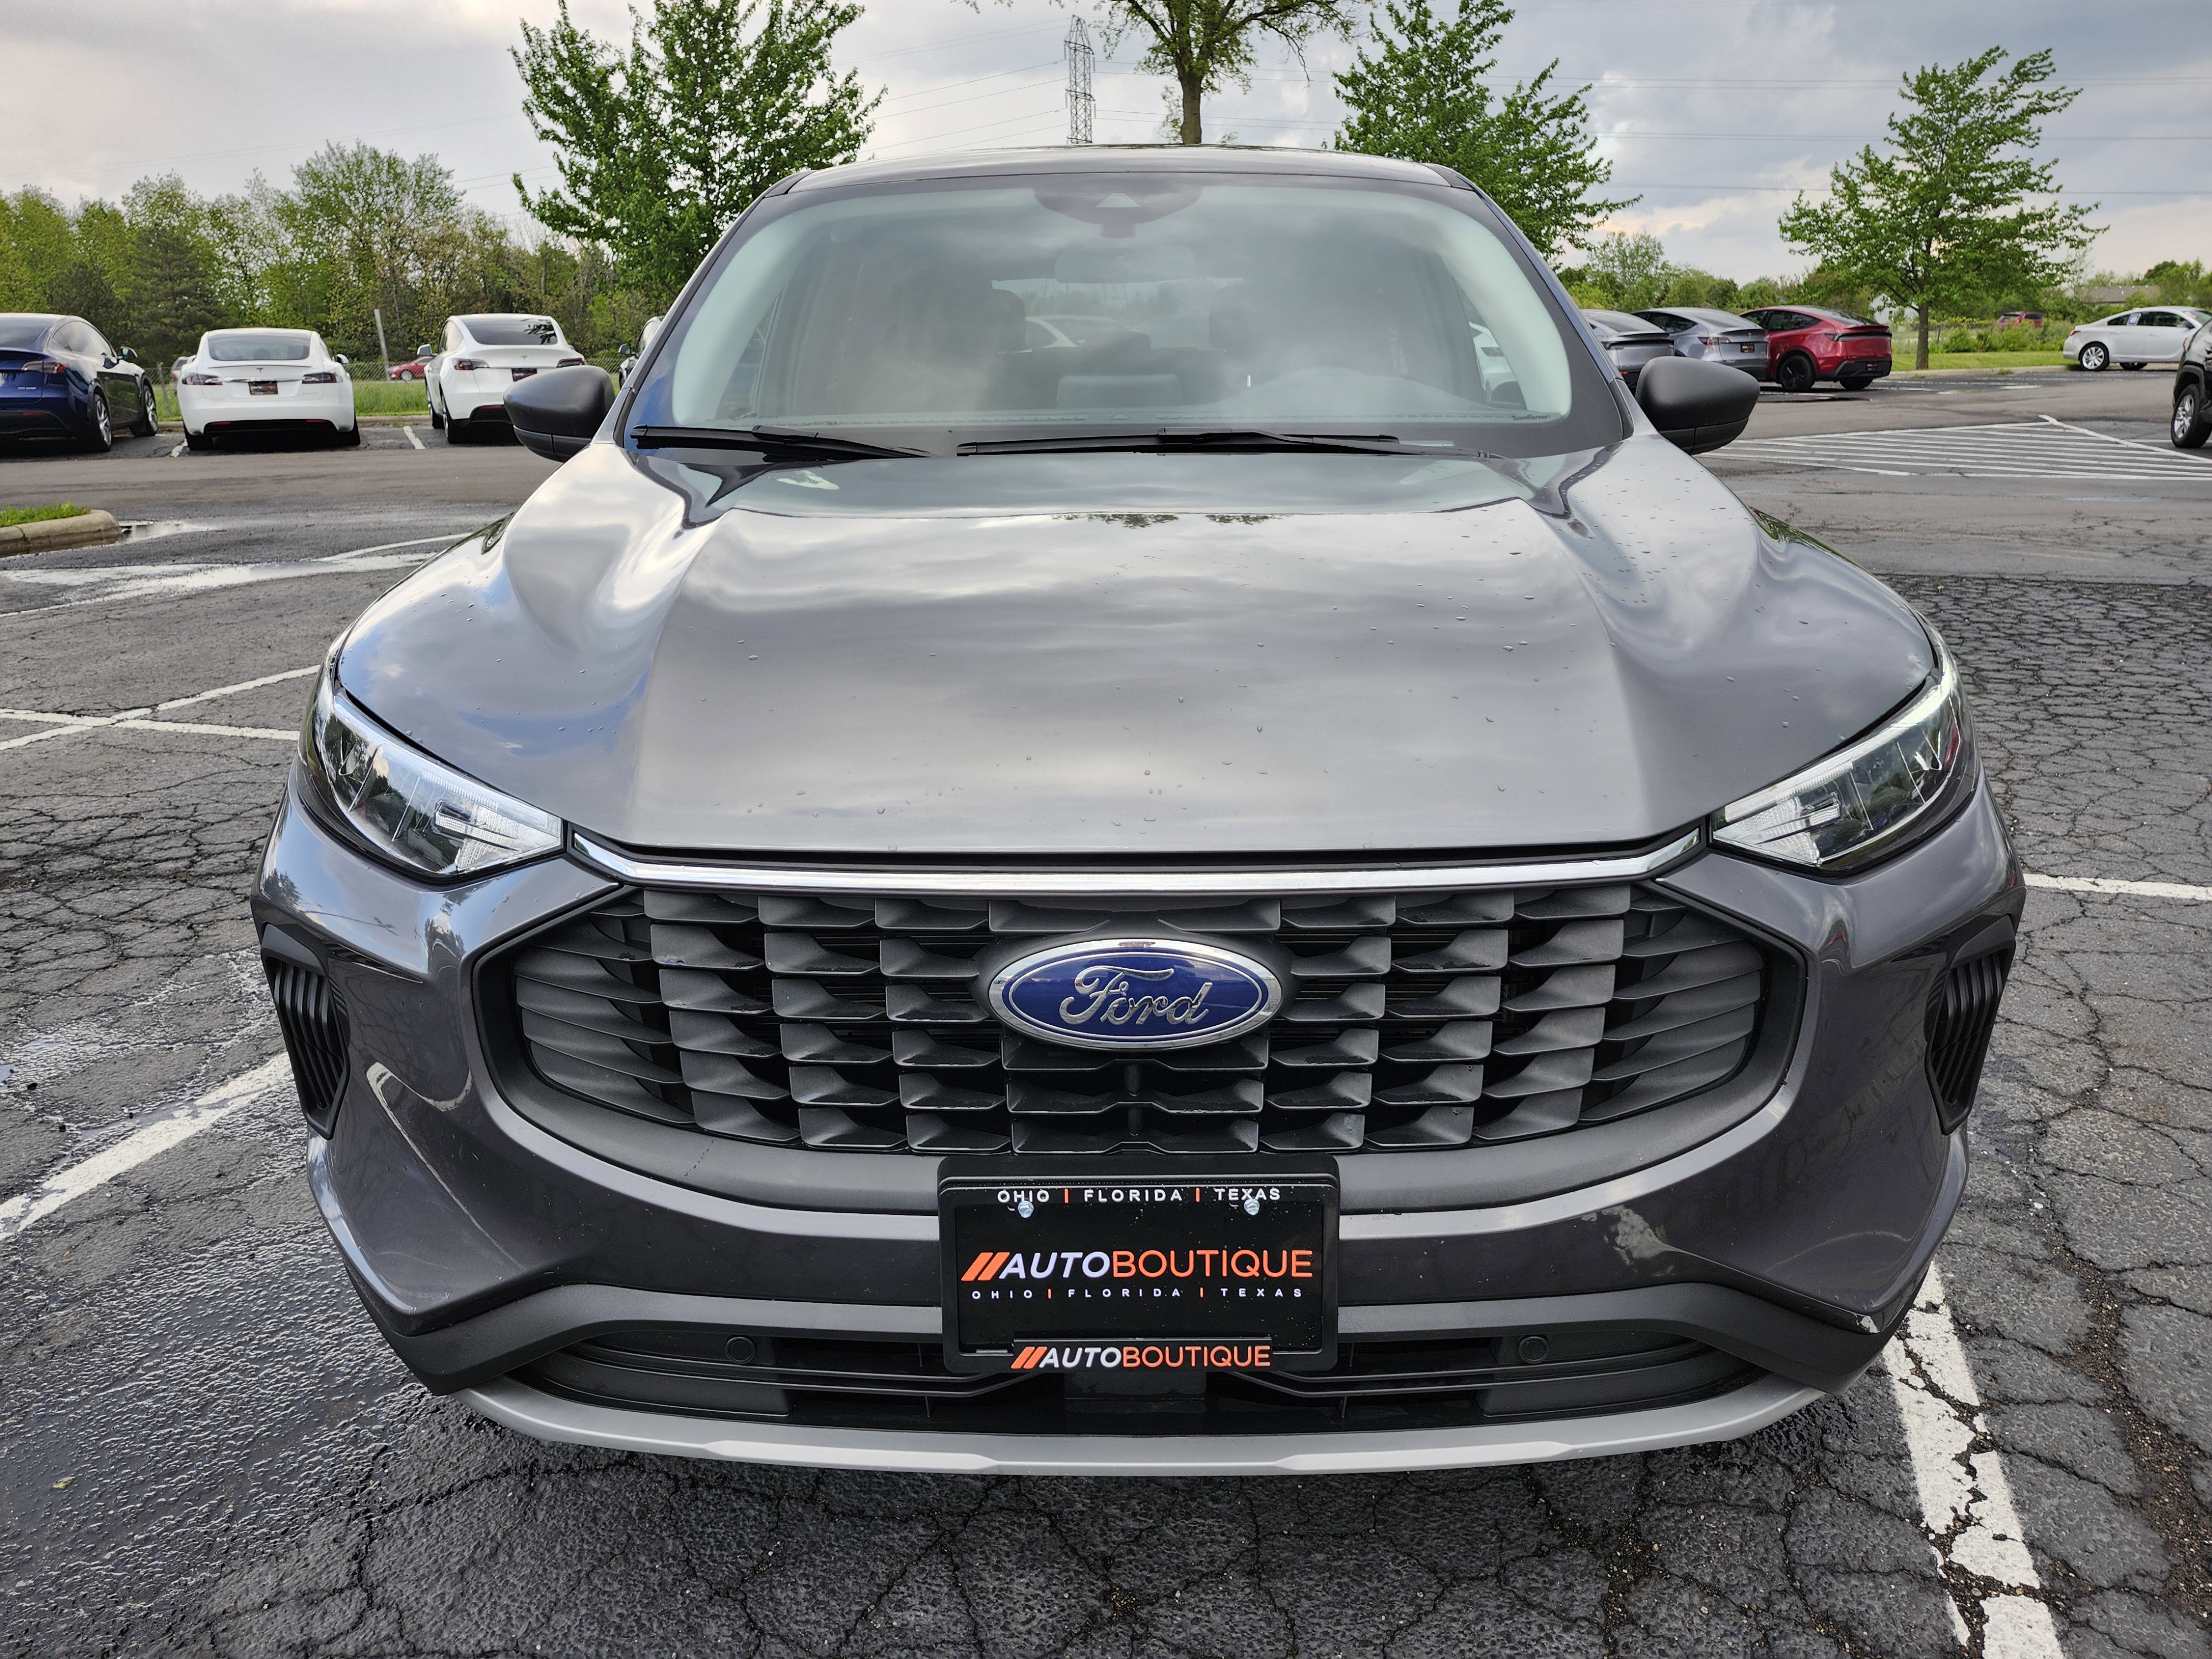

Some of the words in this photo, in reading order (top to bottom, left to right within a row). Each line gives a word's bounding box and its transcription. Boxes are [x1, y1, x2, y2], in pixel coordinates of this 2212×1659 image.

[1059, 966, 1213, 1025] Ford
[997, 1189, 1050, 1204] OHIO
[1084, 1188, 1183, 1203] FLORIDA
[1215, 1187, 1281, 1202] TEXAS
[972, 1290, 1033, 1300] OHIO
[1068, 1288, 1181, 1298] FLORIDA
[1220, 1287, 1302, 1298] TEXAS
